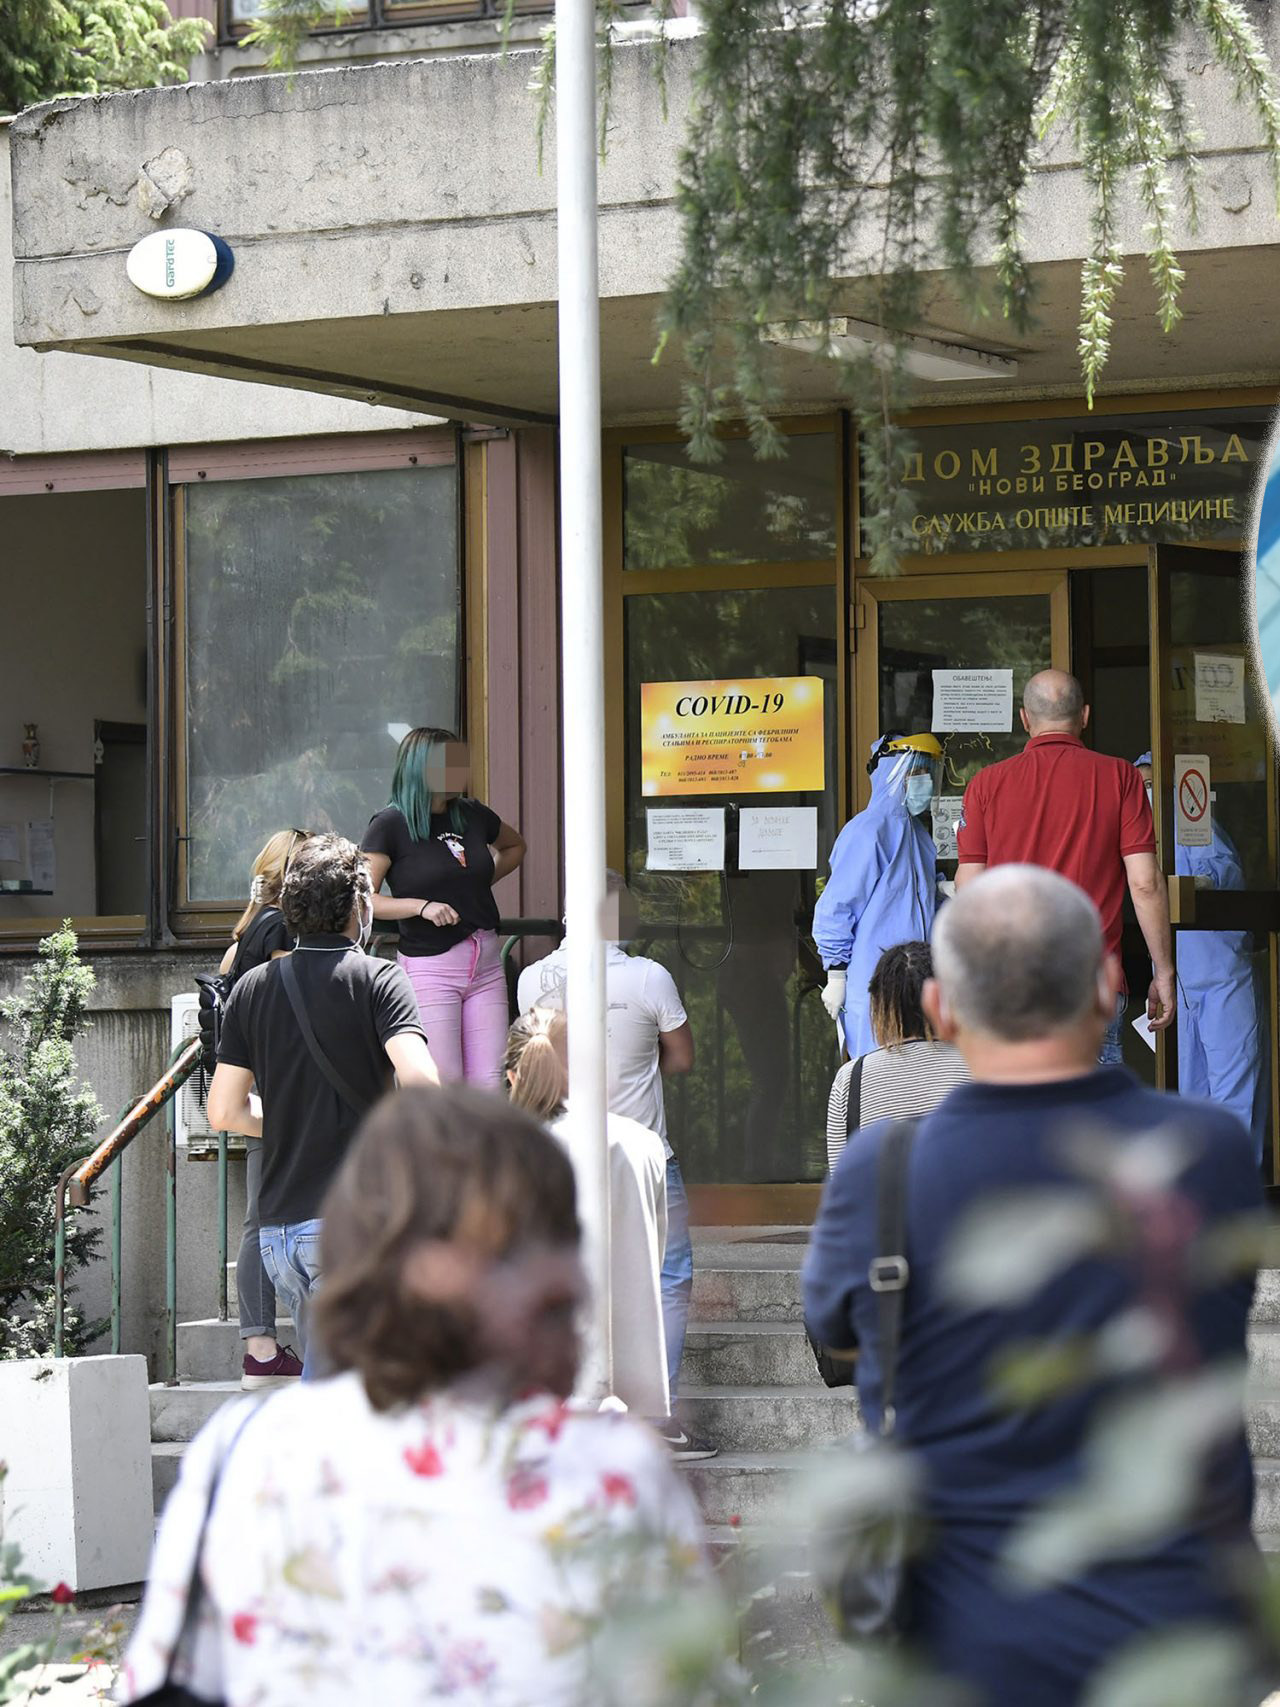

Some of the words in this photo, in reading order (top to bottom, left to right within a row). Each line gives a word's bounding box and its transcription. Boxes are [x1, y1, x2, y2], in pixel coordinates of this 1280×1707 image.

[901, 447, 998, 482] ДОМ
[1020, 434, 1248, 473] ЗДРАВЉА
[911, 511, 1005, 536] СЛУЖБА
[1016, 505, 1094, 530] ОПШТЕ
[1104, 498, 1234, 526] МЕДИЦИНЕ
[676, 693, 784, 717] COVID-19
